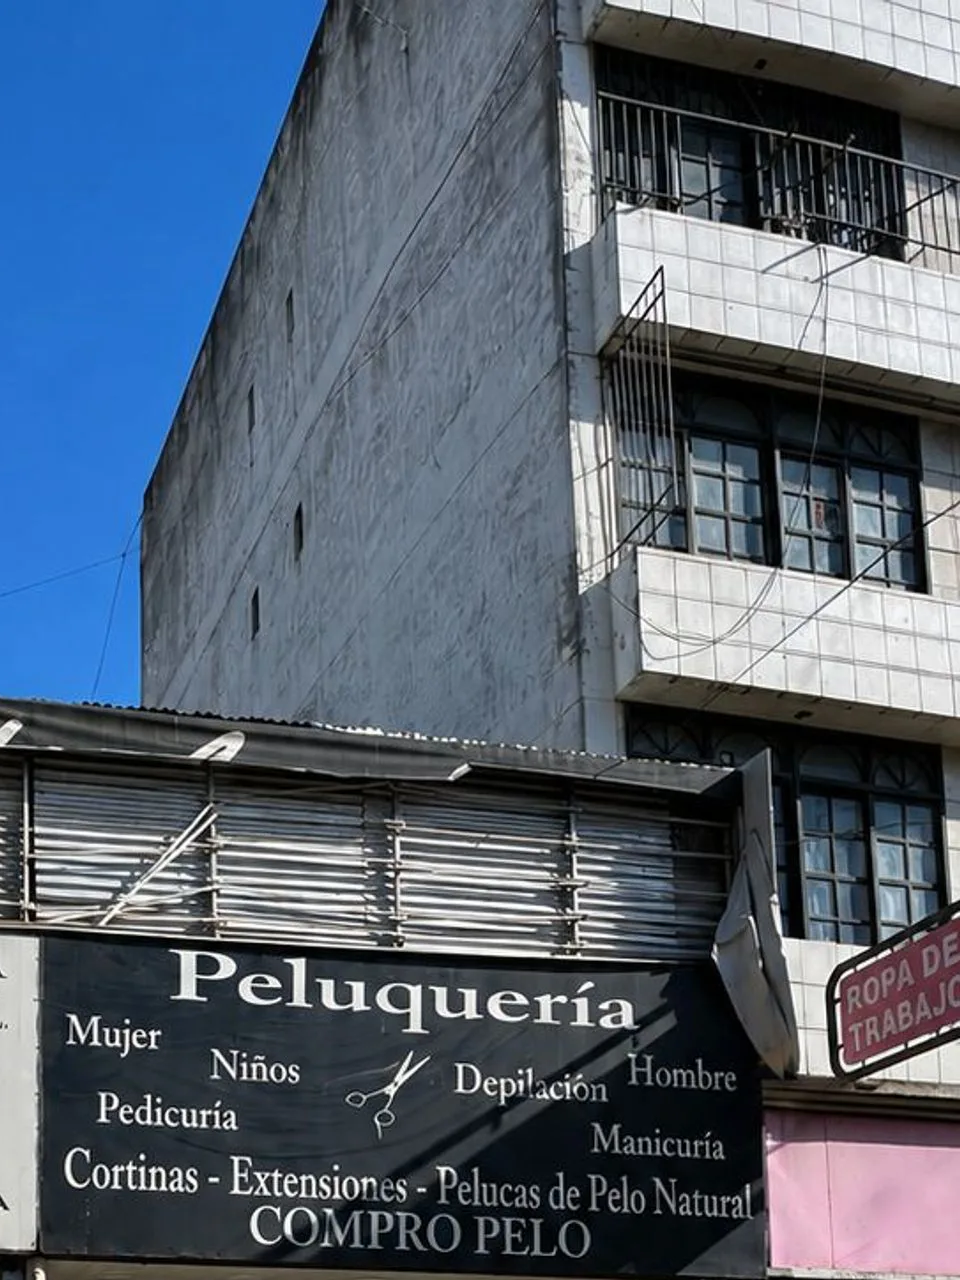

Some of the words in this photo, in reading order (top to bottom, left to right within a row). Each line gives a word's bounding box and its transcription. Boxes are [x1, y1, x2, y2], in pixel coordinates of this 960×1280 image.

[168, 949, 639, 1034] Peluquería
[846, 958, 915, 1015] ROPA
[922, 931, 960, 979] DE
[65, 1012, 163, 1058] Mujer
[848, 974, 960, 1052] TRABAJO
[209, 1047, 301, 1085] Niños
[453, 1061, 609, 1107] Depilación
[627, 1053, 738, 1092] Hombre
[96, 1091, 239, 1131] Pedicuría
[590, 1122, 726, 1161] Manicuría
[63, 1146, 199, 1193] Cortinas
[228, 1155, 408, 1203] Extensiones
[435, 1165, 542, 1210] Pelucas
[548, 1171, 581, 1212] de
[587, 1173, 646, 1215] Pelo
[651, 1176, 756, 1220] Natural
[249, 1205, 462, 1254] COMPRO
[473, 1215, 592, 1259] PELO
